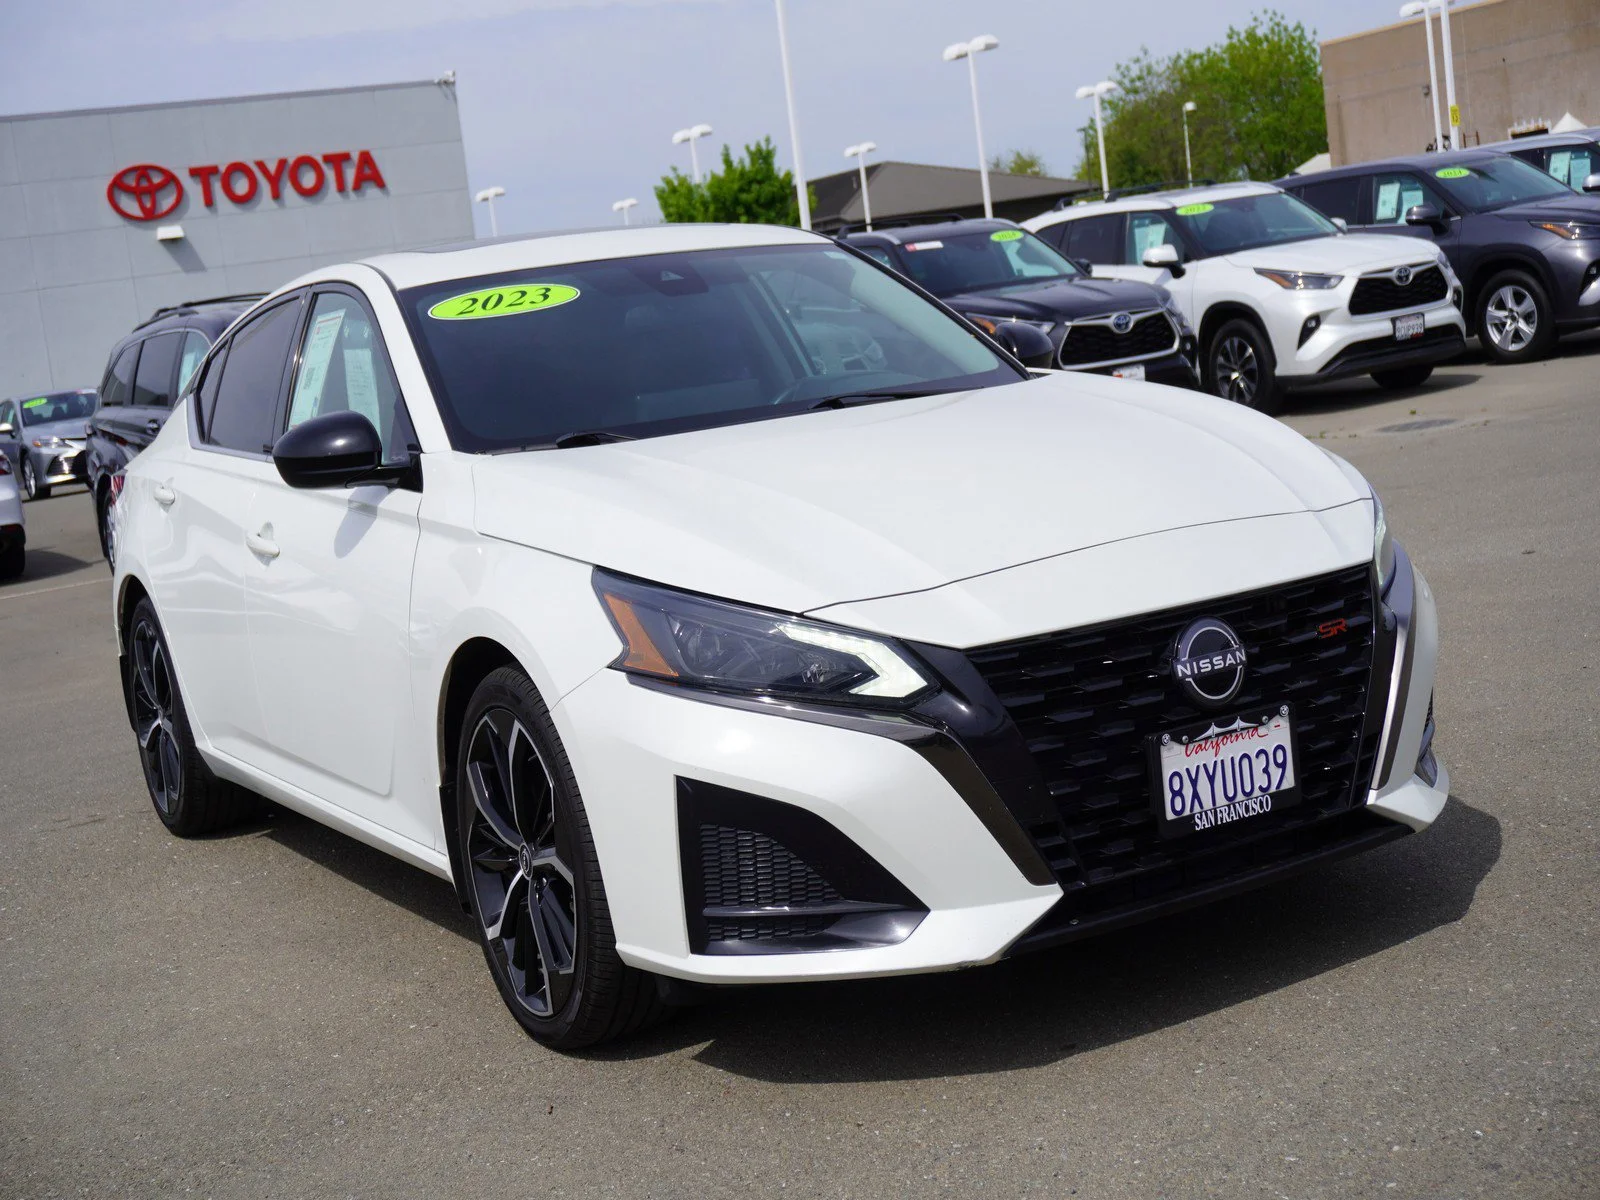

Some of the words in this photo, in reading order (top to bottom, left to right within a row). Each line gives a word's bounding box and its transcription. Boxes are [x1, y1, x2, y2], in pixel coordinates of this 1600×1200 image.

[188, 150, 387, 208] TOYOTA
[455, 287, 552, 317] 2023
[1319, 618, 1347, 639] SR
[1176, 648, 1247, 677] NISSAN
[1184, 727, 1268, 758] California
[1168, 743, 1288, 817] 8XYU039
[1194, 809, 1216, 831] SAN
[1217, 794, 1272, 825] FRANCISCO
